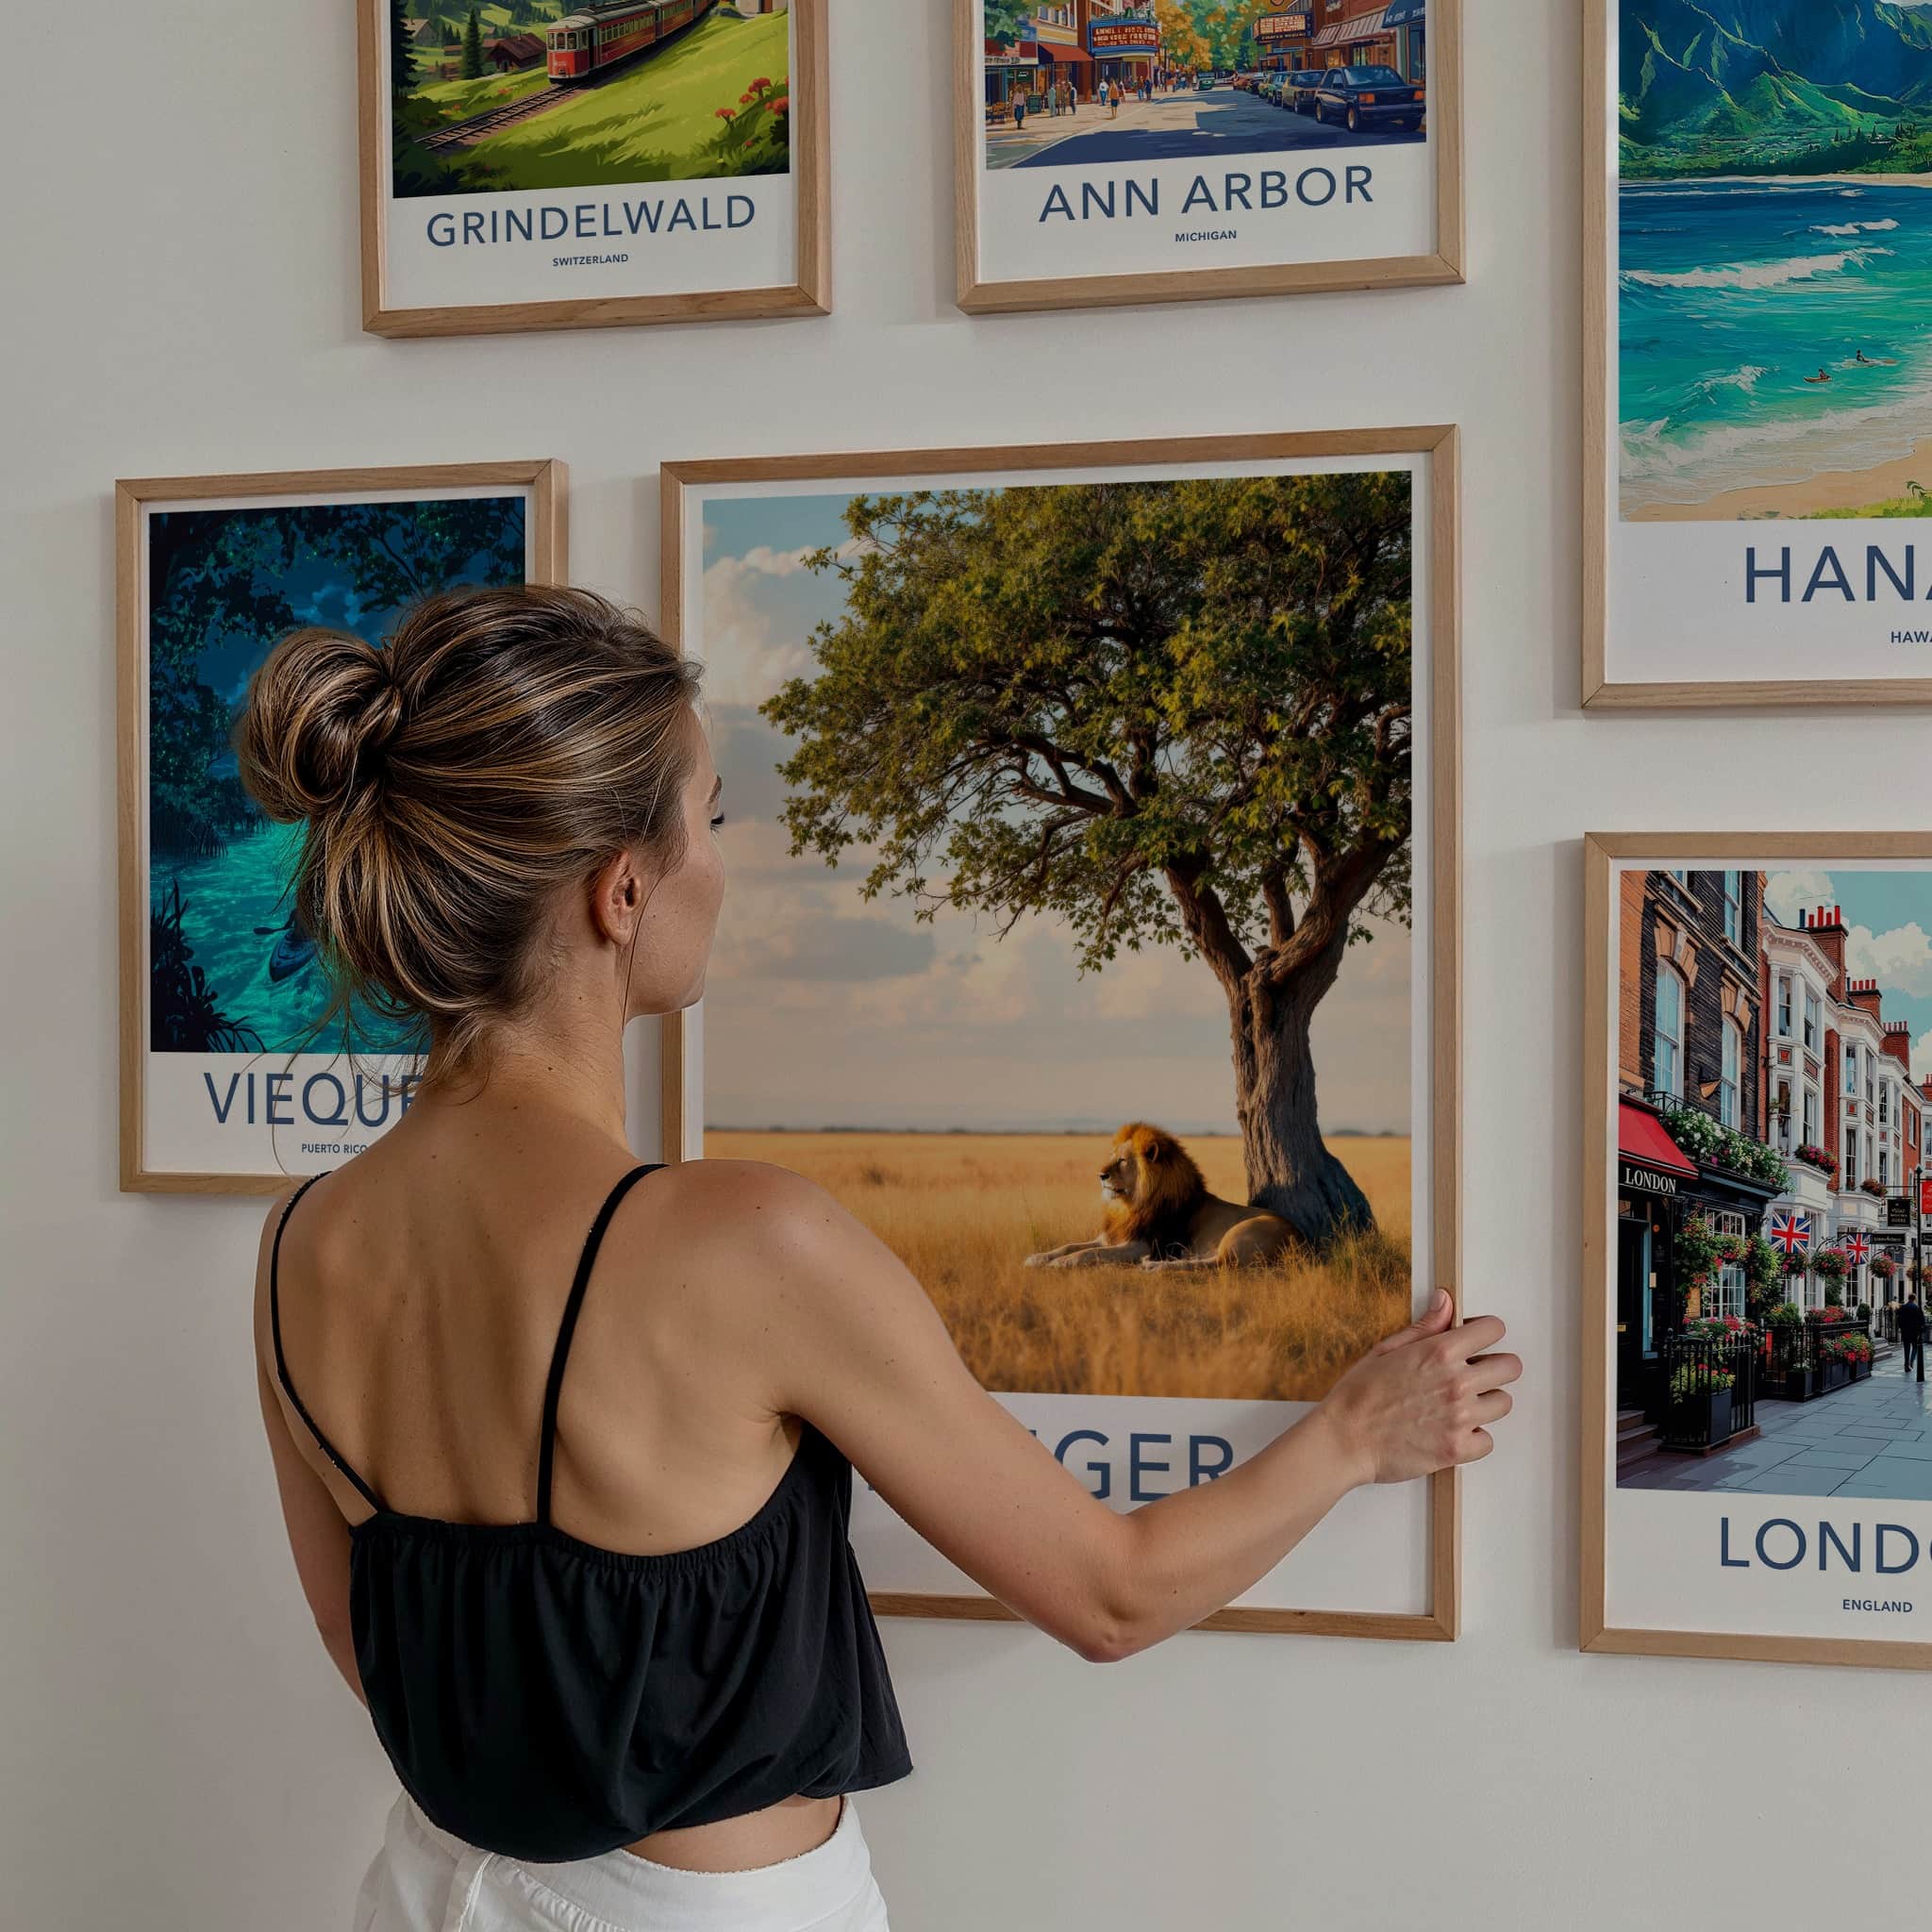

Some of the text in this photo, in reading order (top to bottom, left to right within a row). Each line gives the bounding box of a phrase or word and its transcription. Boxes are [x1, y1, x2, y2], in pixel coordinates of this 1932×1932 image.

[1039, 165, 1374, 224] ANN ARBOR
[426, 194, 756, 247] GRINDELWALD
[1174, 229, 1238, 242] MICHIGAN
[552, 253, 629, 267] SWITZERLAND
[1745, 544, 1932, 603] HAN
[1890, 630, 1932, 643] HAW
[301, 1142, 341, 1154] PUERTO
[1624, 1167, 1676, 1193] LONDON
[1721, 1516, 1932, 1574] LOND
[1841, 1598, 1913, 1613] ENGLAND
